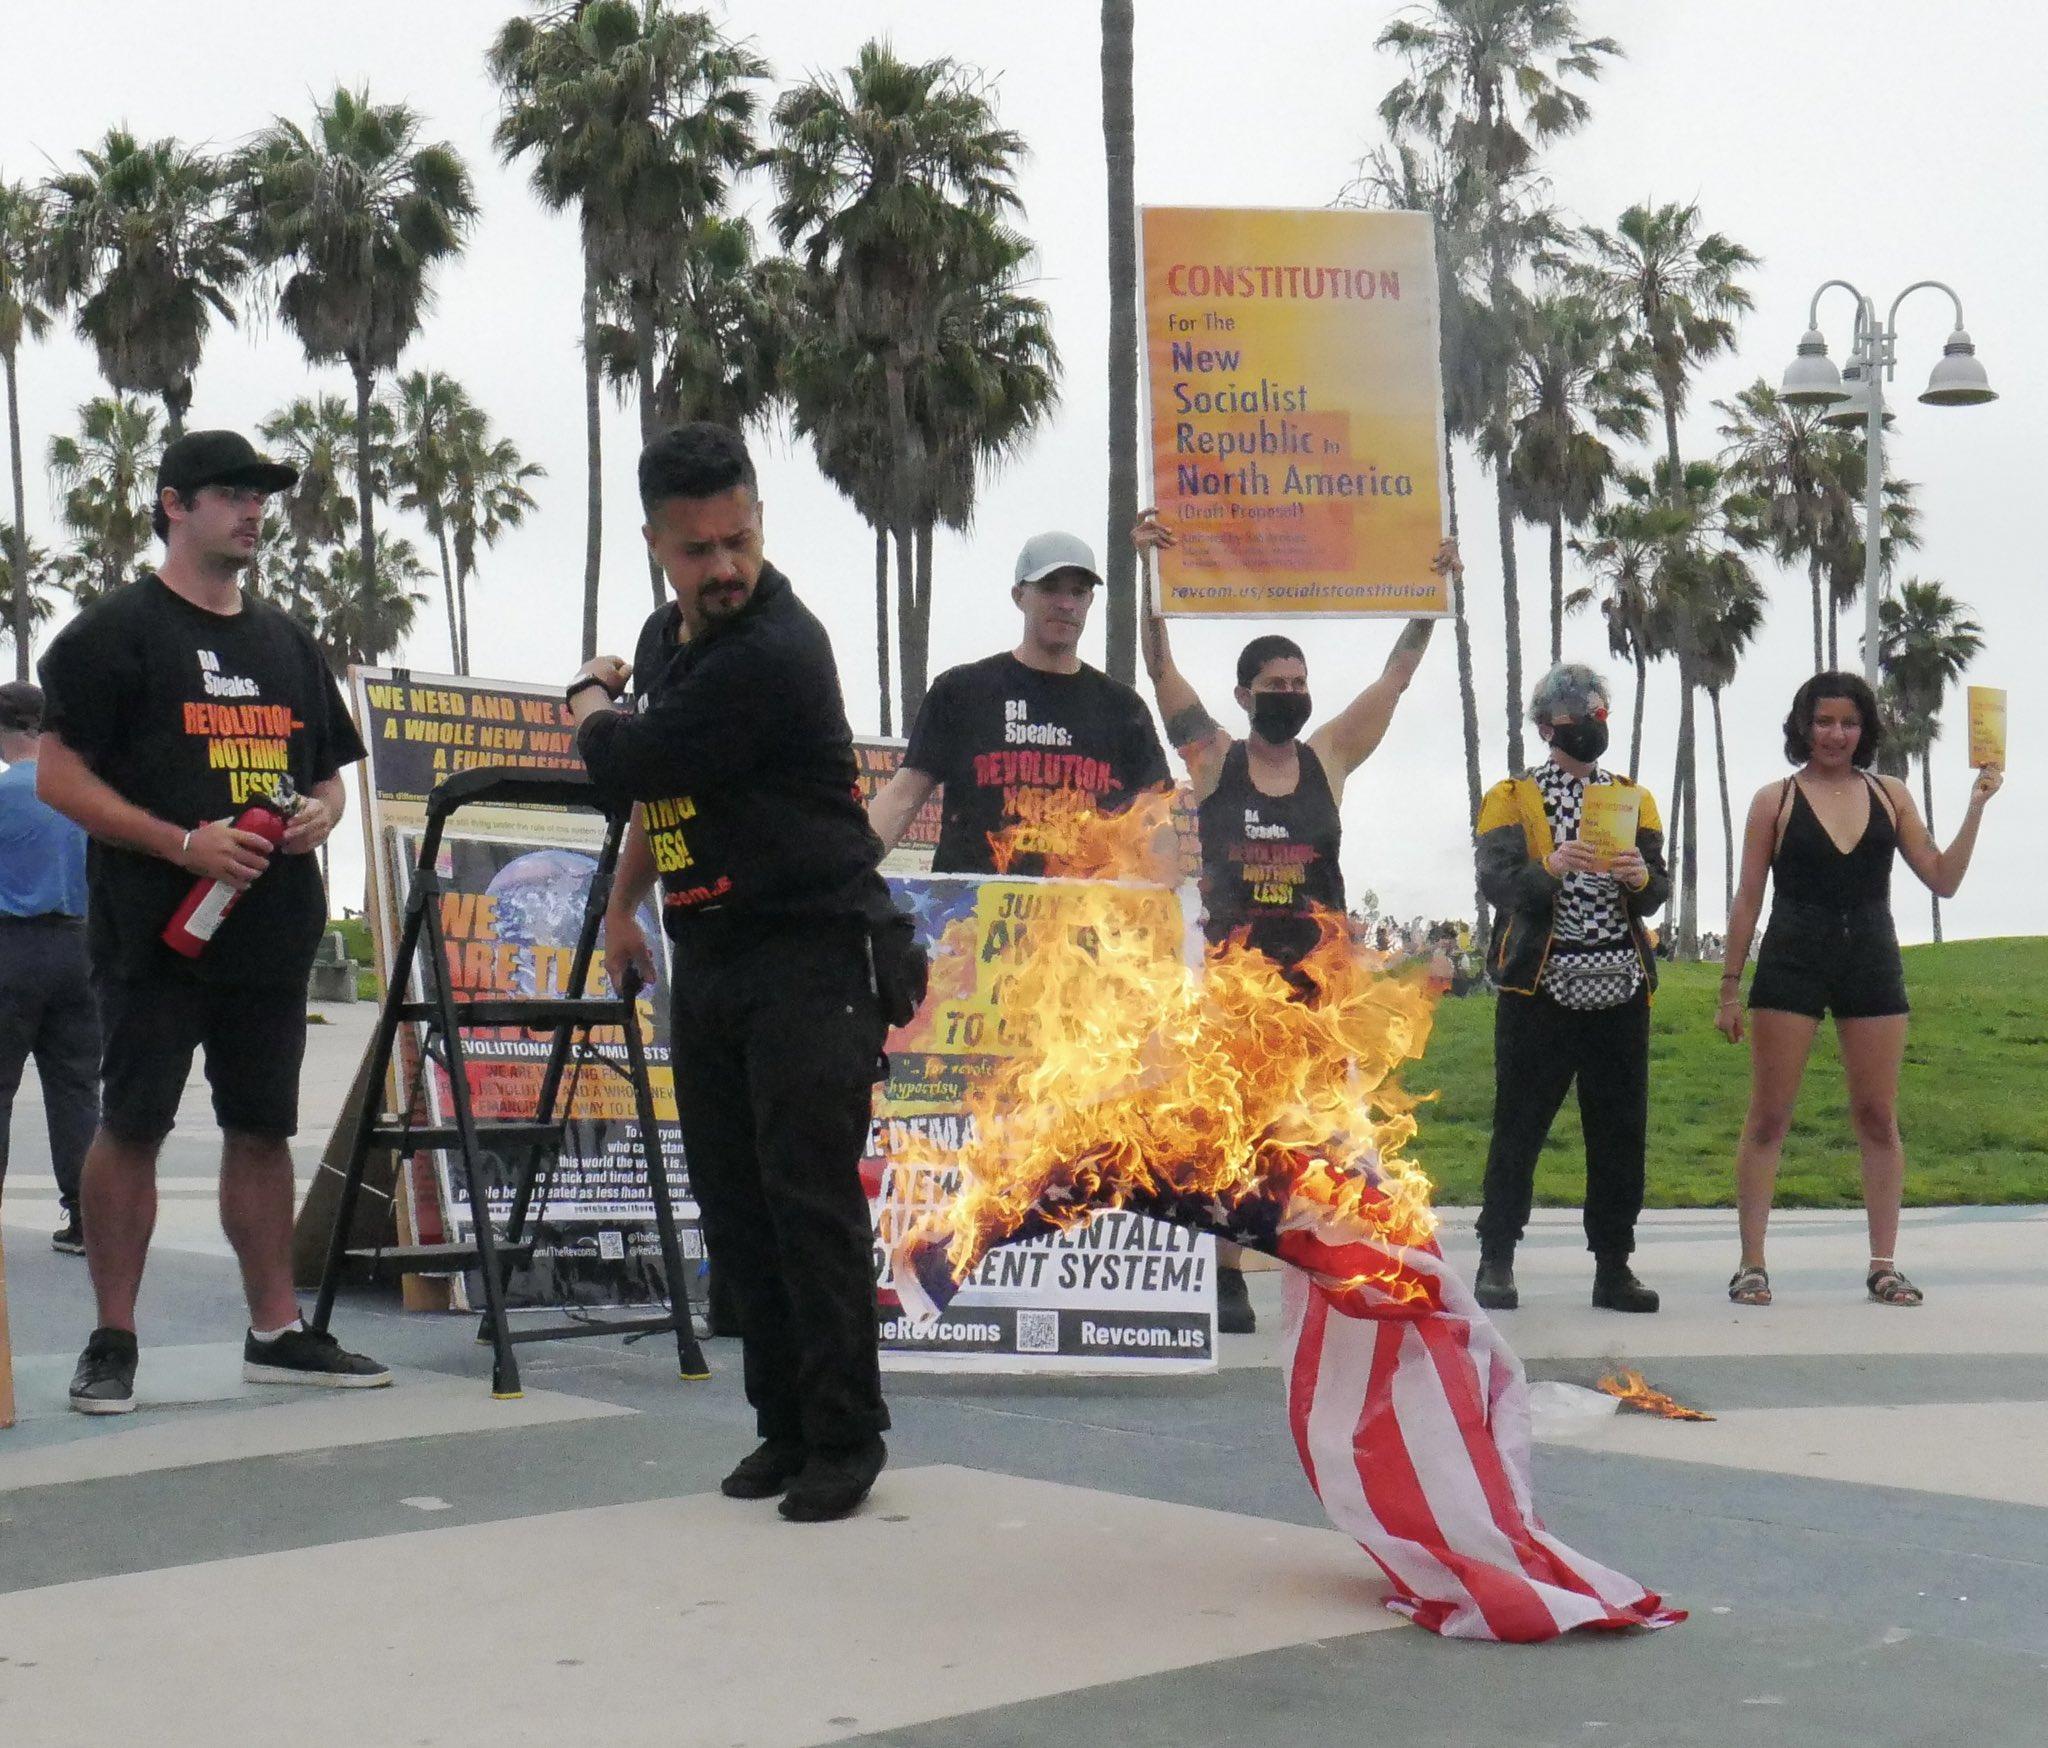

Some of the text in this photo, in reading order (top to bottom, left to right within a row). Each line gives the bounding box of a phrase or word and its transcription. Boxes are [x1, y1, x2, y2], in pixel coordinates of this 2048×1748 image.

[1167, 264, 1401, 300] CONSTITUTION
[1169, 311, 1236, 332] For The
[1171, 341, 1241, 374] New
[1172, 378, 1307, 414] Socialist
[1176, 419, 1314, 461] Republic
[1177, 461, 1413, 496] North America
[203, 671, 261, 698] Speaks:
[366, 685, 406, 713] WE
[411, 690, 466, 717] NEED
[472, 695, 517, 722] AND
[521, 700, 556, 726] WE
[1005, 699, 1027, 721] BA
[383, 717, 573, 755] A WHOLE NEW WAY
[1004, 722, 1073, 747] Speaks:
[208, 737, 289, 771] NOTHING
[433, 748, 448, 770] A
[440, 892, 499, 940] WE
[946, 1011, 985, 1048] TO
[625, 1125, 638, 1139] To
[559, 1155, 579, 1168] this
[582, 1156, 613, 1168] world
[616, 1156, 634, 1169] the
[608, 1140, 630, 1154] who
[660, 1144, 685, 1155] stan
[561, 1170, 583, 1184] sick
[585, 1170, 608, 1183] and
[610, 1170, 636, 1184] tired
[637, 1170, 648, 1184] of
[579, 1187, 592, 1199] as
[596, 1185, 617, 1199] less
[618, 1185, 641, 1199] than
[1058, 1253, 1205, 1292] SYSTEM!
[1081, 1320, 1206, 1348] Revcom.us
